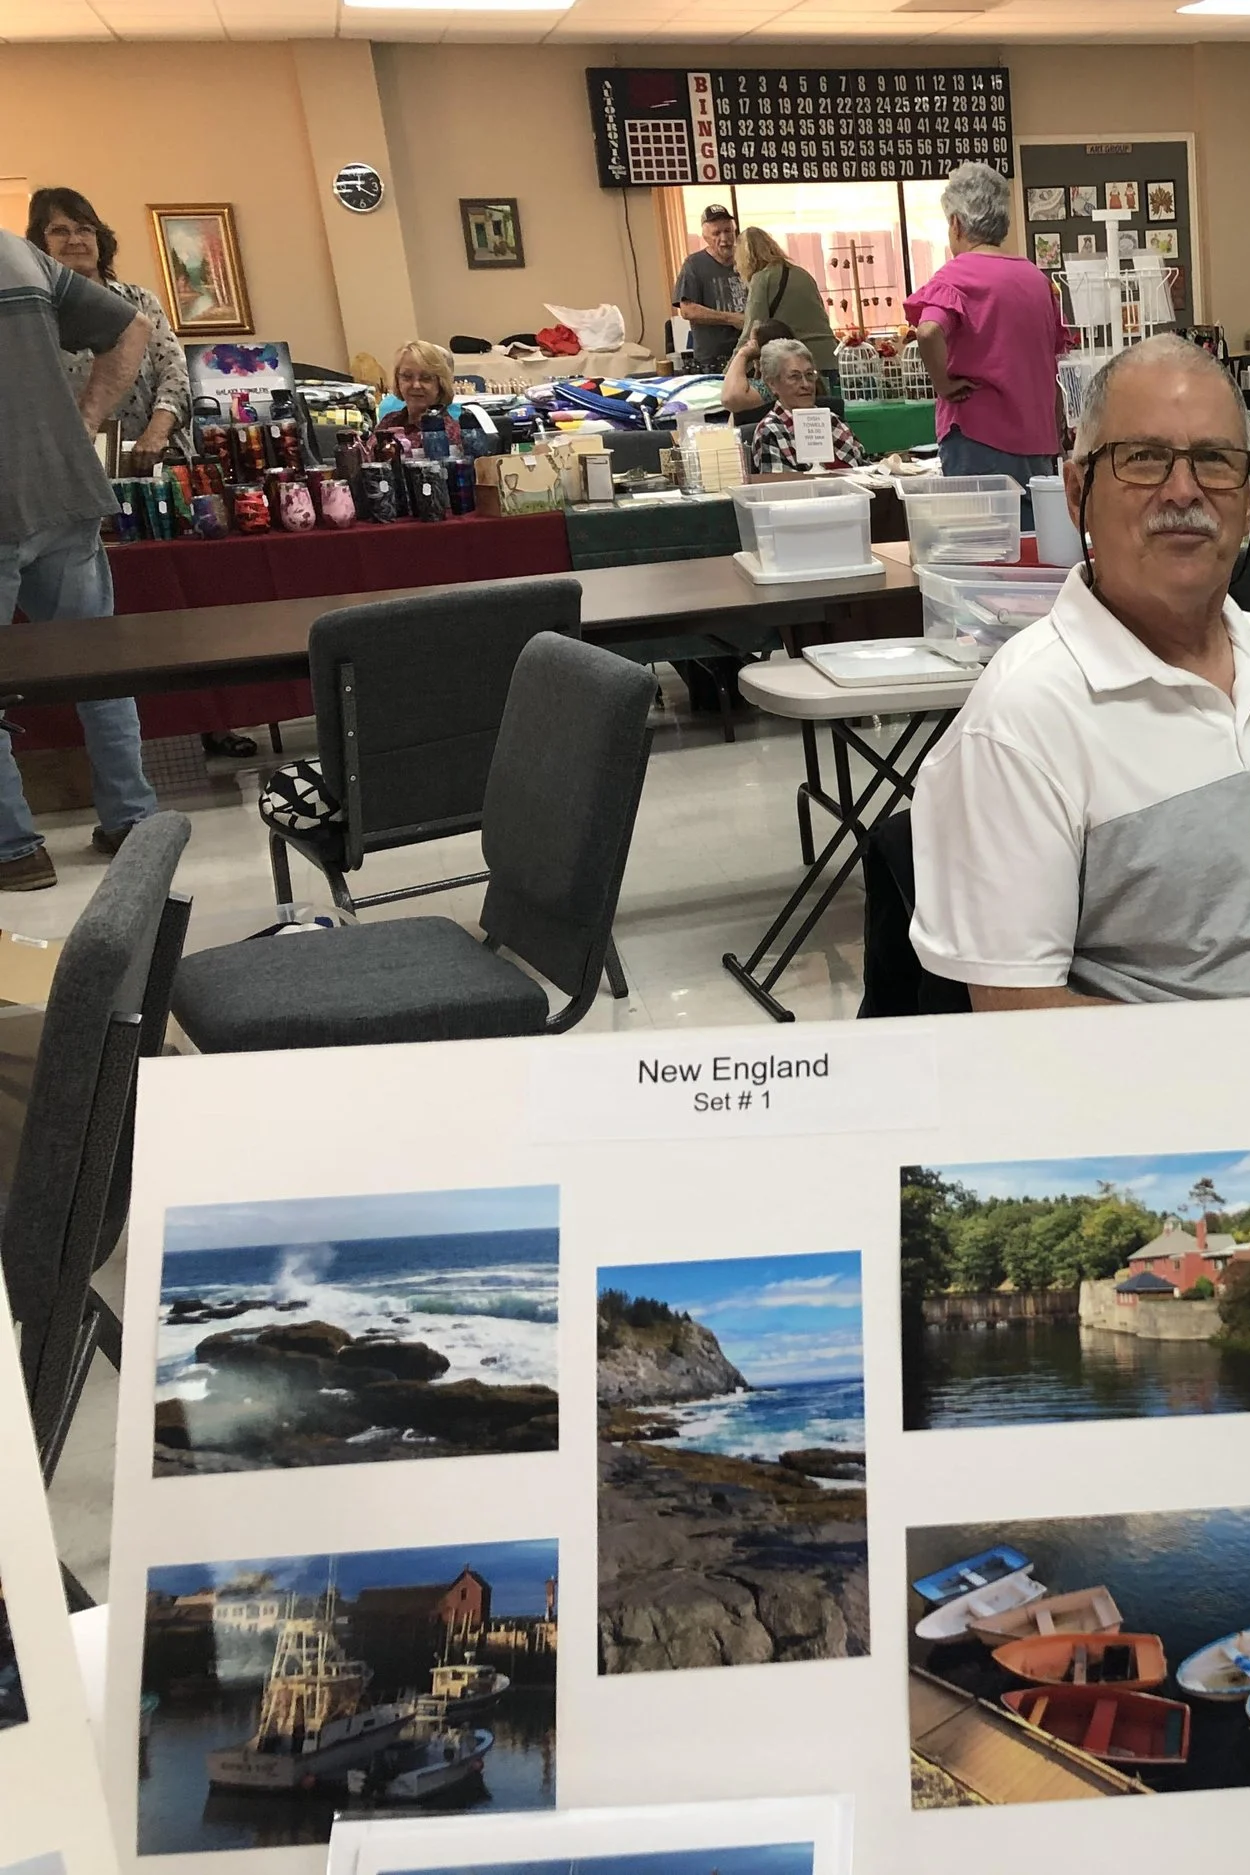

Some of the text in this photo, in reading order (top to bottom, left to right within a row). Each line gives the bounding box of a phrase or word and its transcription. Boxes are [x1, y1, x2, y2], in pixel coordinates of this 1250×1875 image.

[718, 75, 1003, 92] 1 2 3 4 5 6 7 8 9 10 11 12 13 14 15
[717, 96, 1005, 115] 16 17 18 19 20 21 22 23 24 25 26 27 28 29 30
[720, 116, 1006, 136] 31 32 33 34 35 36 37 38 39 40 41 42 43 44 45
[720, 137, 1007, 158] 46 47 48 49 50 51 52 53 54 55 56 57 58 59 60
[723, 163, 737, 179] 61
[743, 162, 759, 179] 62
[762, 162, 779, 178] 63
[782, 162, 798, 178] 64
[803, 161, 818, 178] 65
[822, 161, 838, 177] 66
[843, 161, 857, 177] 67
[861, 160, 876, 176] 68
[881, 160, 895, 176] 69
[900, 160, 914, 176] 70
[921, 159, 932, 175] 71
[938, 159, 952, 175] 72
[995, 158, 1009, 174] 75
[638, 1053, 829, 1086] New England
[694, 1090, 770, 1112] Set # 1
